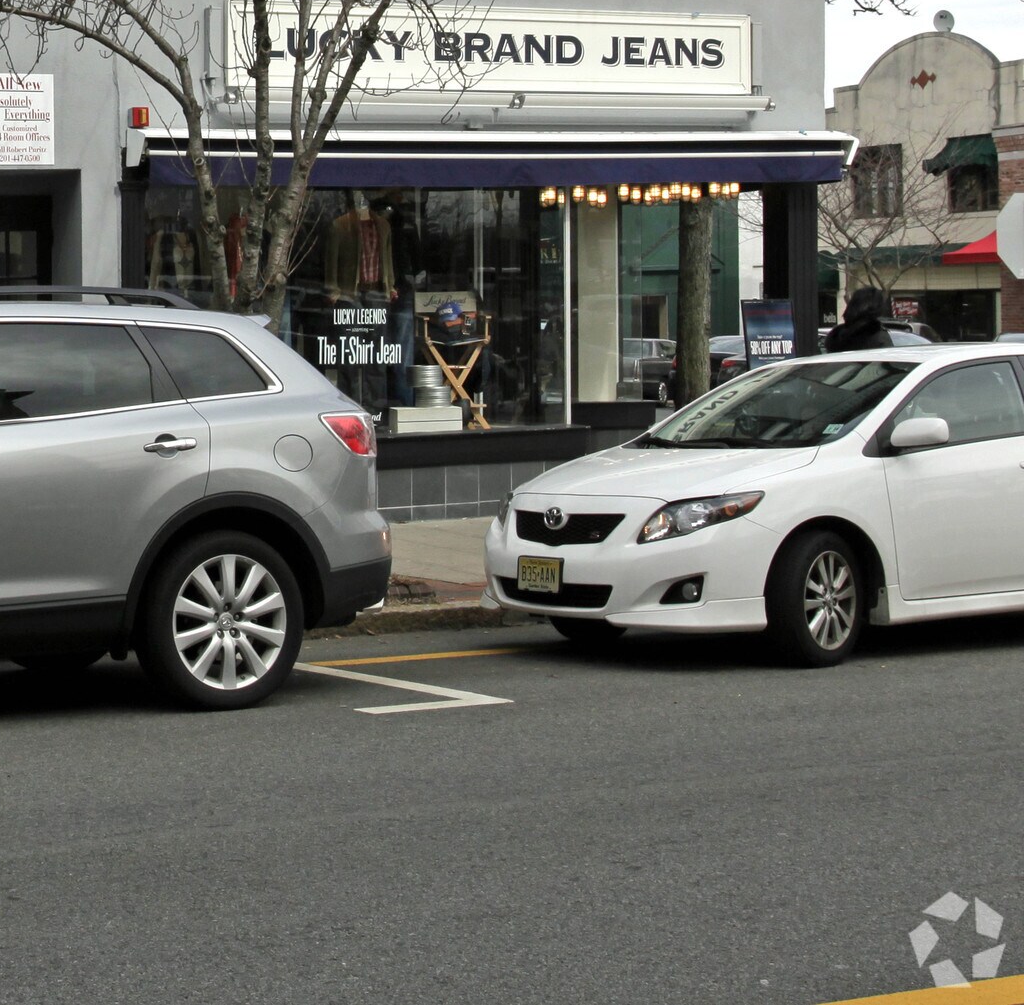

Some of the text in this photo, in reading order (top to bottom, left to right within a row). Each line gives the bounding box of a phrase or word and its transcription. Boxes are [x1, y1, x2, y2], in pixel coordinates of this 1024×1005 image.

[434, 32, 585, 65] BRAND
[600, 36, 725, 69] JEANS
[15, 77, 42, 90] New
[4, 109, 51, 123] Everything
[2, 124, 37, 132] Customized
[3, 132, 24, 141] Room
[25, 132, 51, 142] Offices
[333, 308, 387, 325] LUCKY LEGENDS
[317, 336, 402, 365] The T-Shirt Jean
[761, 340, 770, 355] OFF
[771, 340, 781, 355] ANY
[781, 340, 793, 354] TOP
